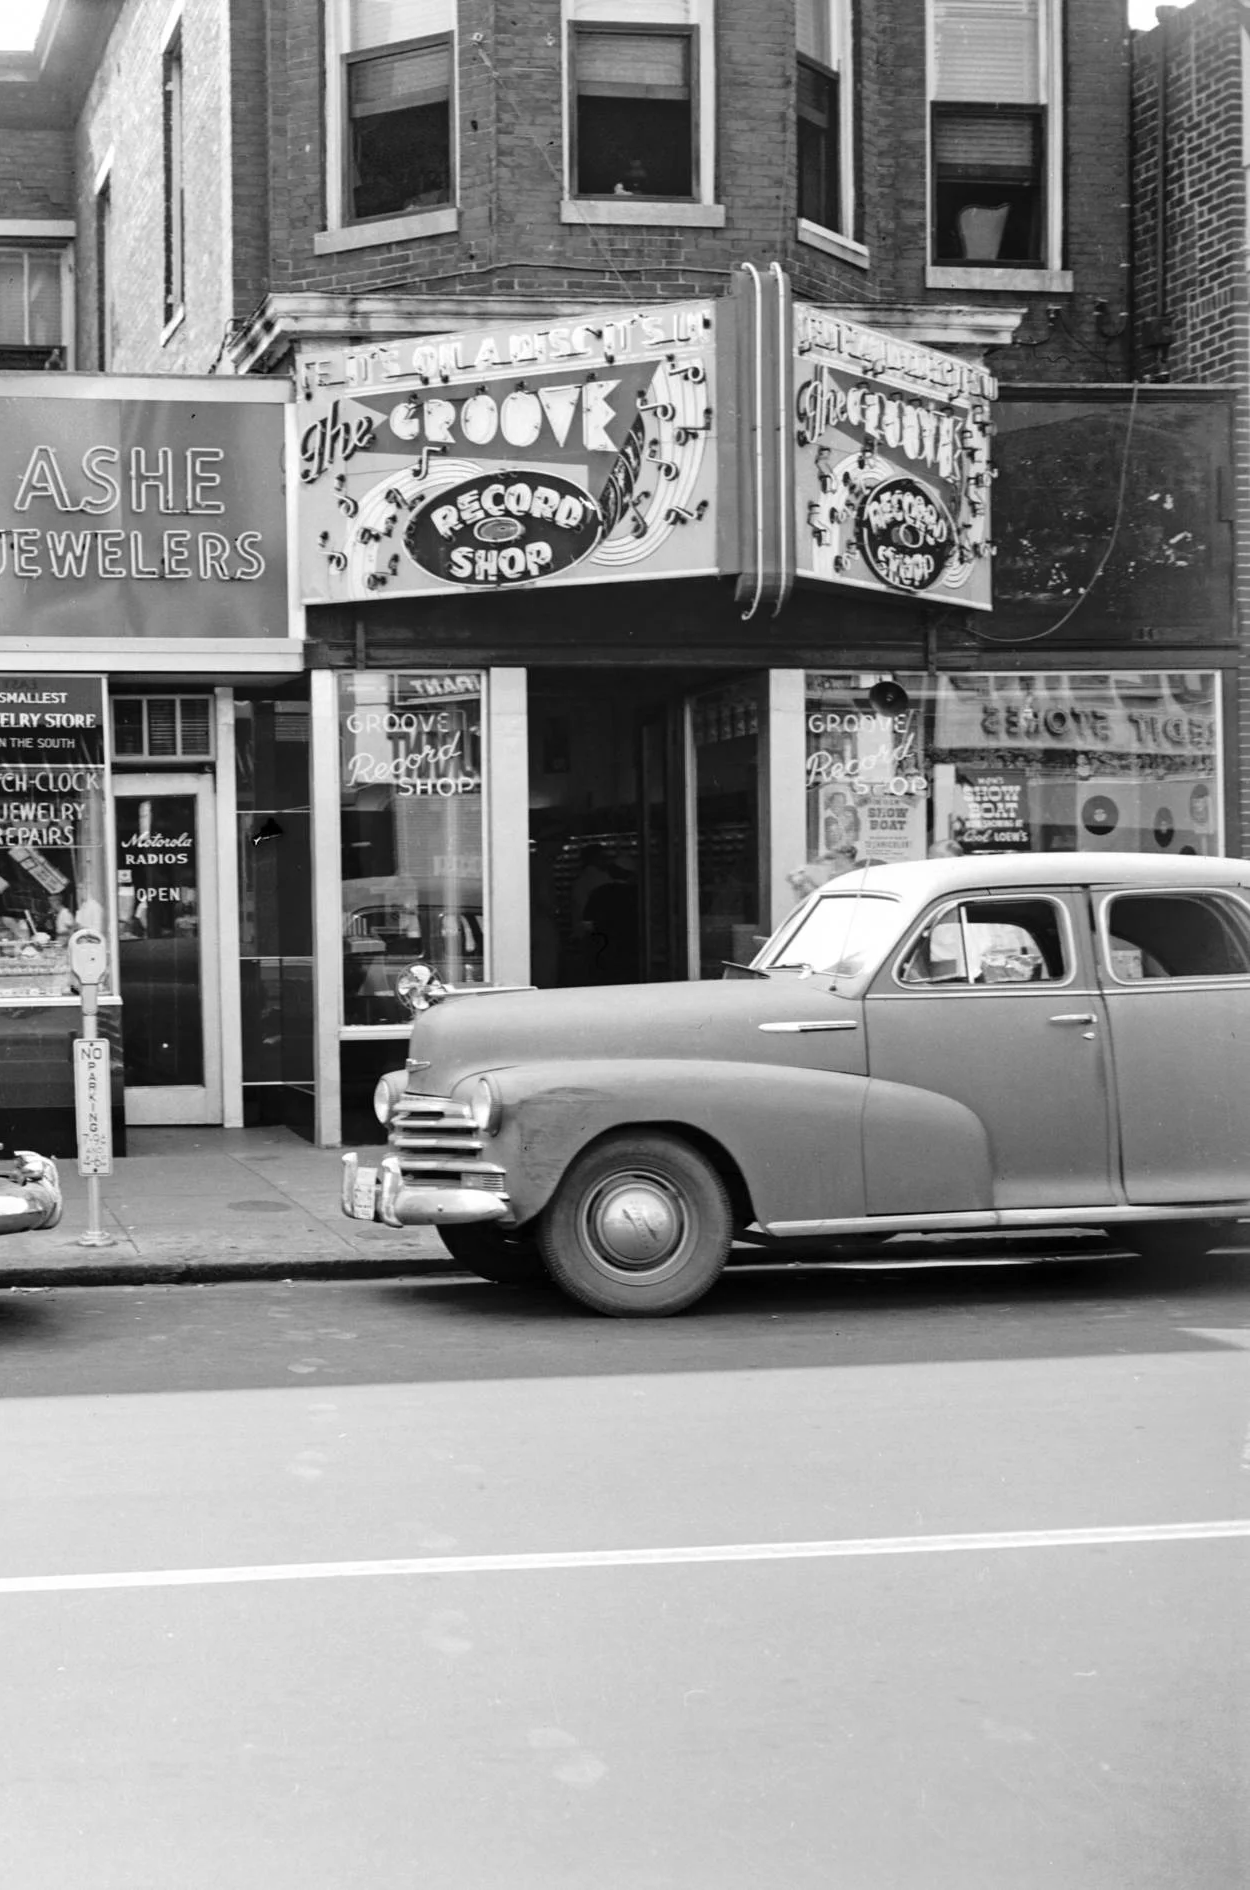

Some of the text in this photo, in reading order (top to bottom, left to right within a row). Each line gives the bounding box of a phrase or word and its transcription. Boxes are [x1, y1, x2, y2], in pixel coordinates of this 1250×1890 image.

[389, 378, 622, 453] GROOVE
[13, 445, 226, 516] ASHE
[430, 481, 596, 541] RECORD
[449, 539, 553, 581] SHOP
[44, 713, 97, 728] STORE
[347, 712, 451, 734] GROOVE
[808, 713, 908, 733] GROOVE
[10, 737, 34, 748] THE
[37, 738, 76, 749] SOUTH
[346, 730, 462, 787] Record
[806, 732, 915, 786] Record
[398, 777, 475, 797] SHOP
[963, 785, 1022, 801] SHOW
[867, 807, 909, 819] SHOW
[968, 801, 1018, 819] BOAT
[870, 819, 907, 831] BOAT
[121, 831, 193, 848] Motorola
[125, 853, 189, 865] RADIOS
[136, 887, 181, 902] OPEN
[80, 1047, 103, 1061] NO
[87, 1061, 99, 1133] PARKING
